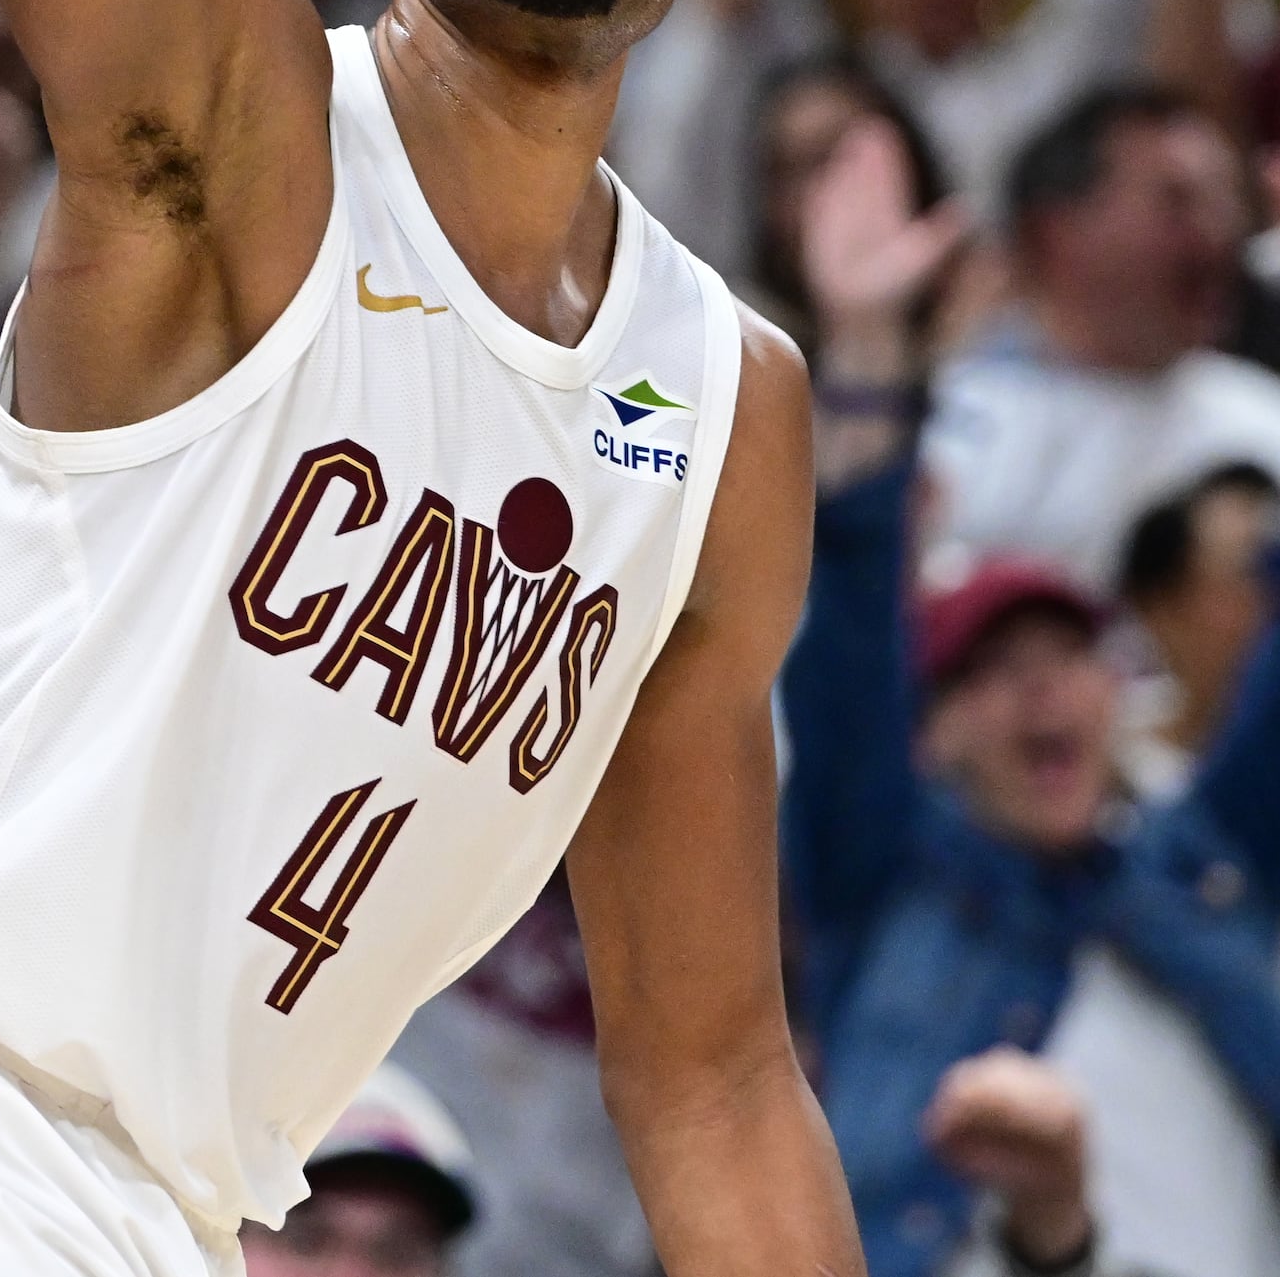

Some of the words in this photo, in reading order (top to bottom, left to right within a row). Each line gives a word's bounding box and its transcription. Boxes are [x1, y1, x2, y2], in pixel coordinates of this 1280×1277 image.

[593, 429, 688, 482] CLIFFS
[228, 438, 618, 795] CAVS
[246, 777, 418, 1015] 4
